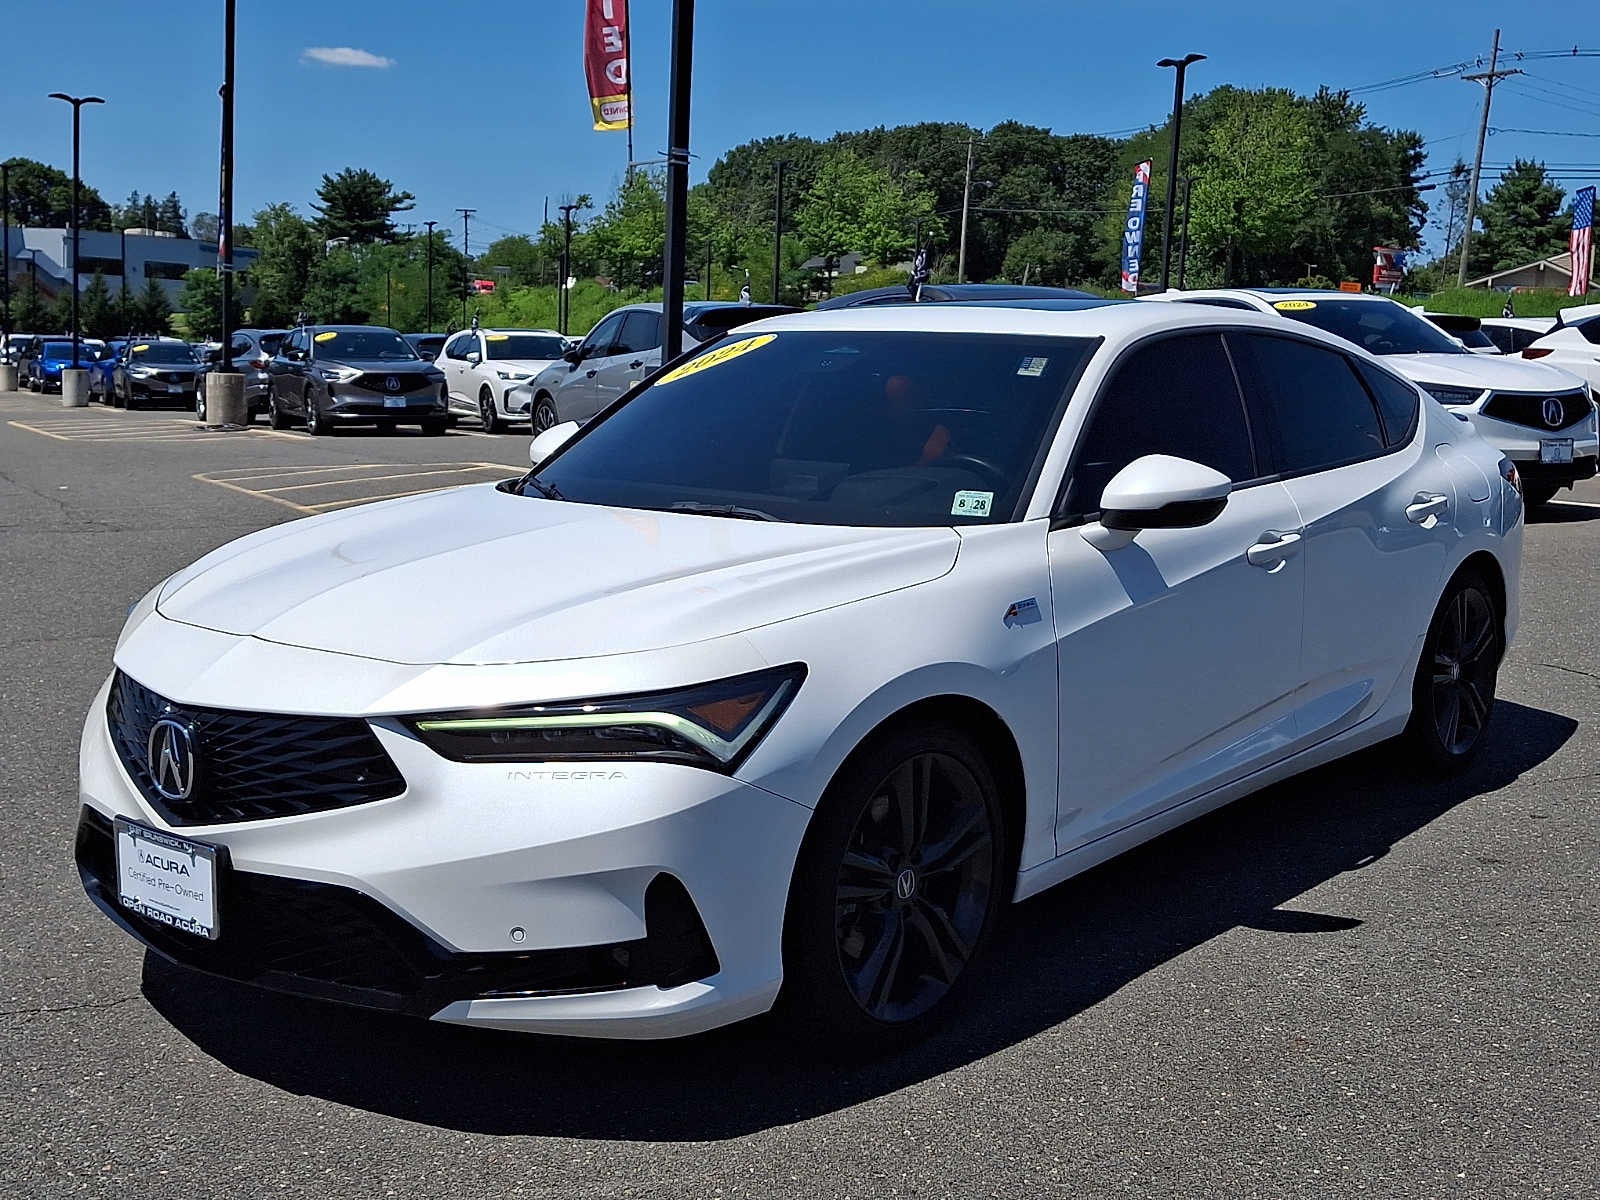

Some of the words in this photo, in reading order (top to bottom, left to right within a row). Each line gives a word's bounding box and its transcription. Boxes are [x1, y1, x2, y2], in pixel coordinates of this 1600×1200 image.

[673, 339, 757, 377] 2024
[959, 499, 966, 508] 8
[973, 500, 986, 510] 28
[506, 771, 628, 781] INTEGRA
[145, 853, 190, 877] ACURA
[129, 867, 156, 887] Certified
[158, 878, 204, 902] Pre-Owned
[123, 897, 145, 915] OPEN
[147, 907, 172, 925] ROAD
[175, 918, 209, 938] ACURA
